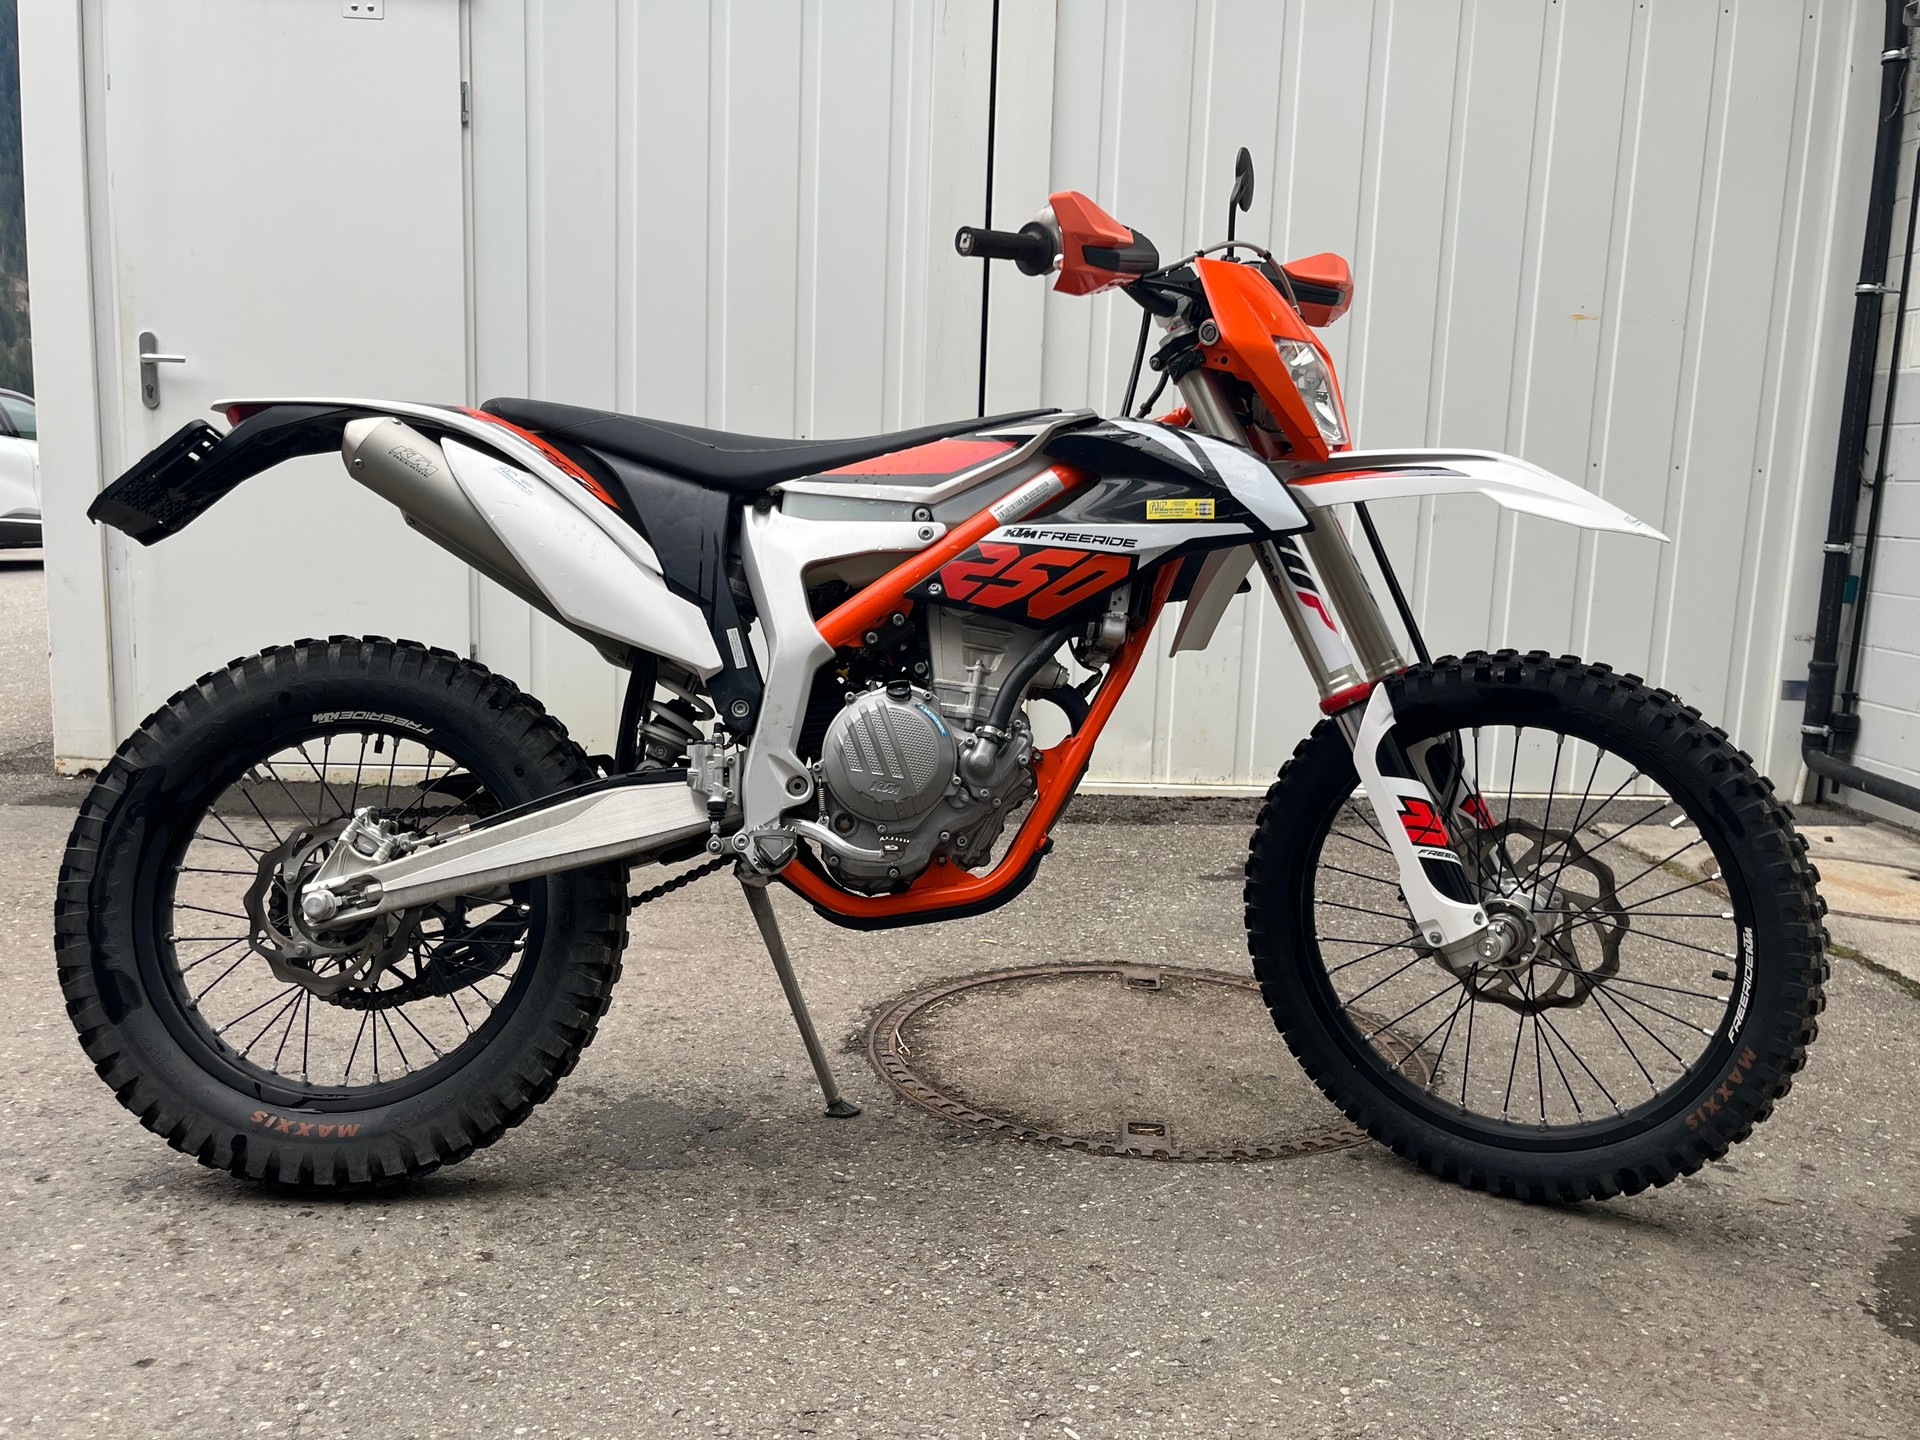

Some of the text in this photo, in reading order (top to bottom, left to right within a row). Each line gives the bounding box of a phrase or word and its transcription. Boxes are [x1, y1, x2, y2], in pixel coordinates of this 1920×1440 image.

[391, 445, 439, 475] KTM
[1003, 527, 1138, 548] KTM FREERIDE
[939, 541, 1132, 620] 250
[312, 711, 434, 735] FREERIDE KTM
[1417, 849, 1460, 862] FREER
[1728, 927, 1753, 1044] FREERIDE KTM
[1684, 1045, 1757, 1131] MAXXIS
[250, 1110, 361, 1138] MAXXIS
